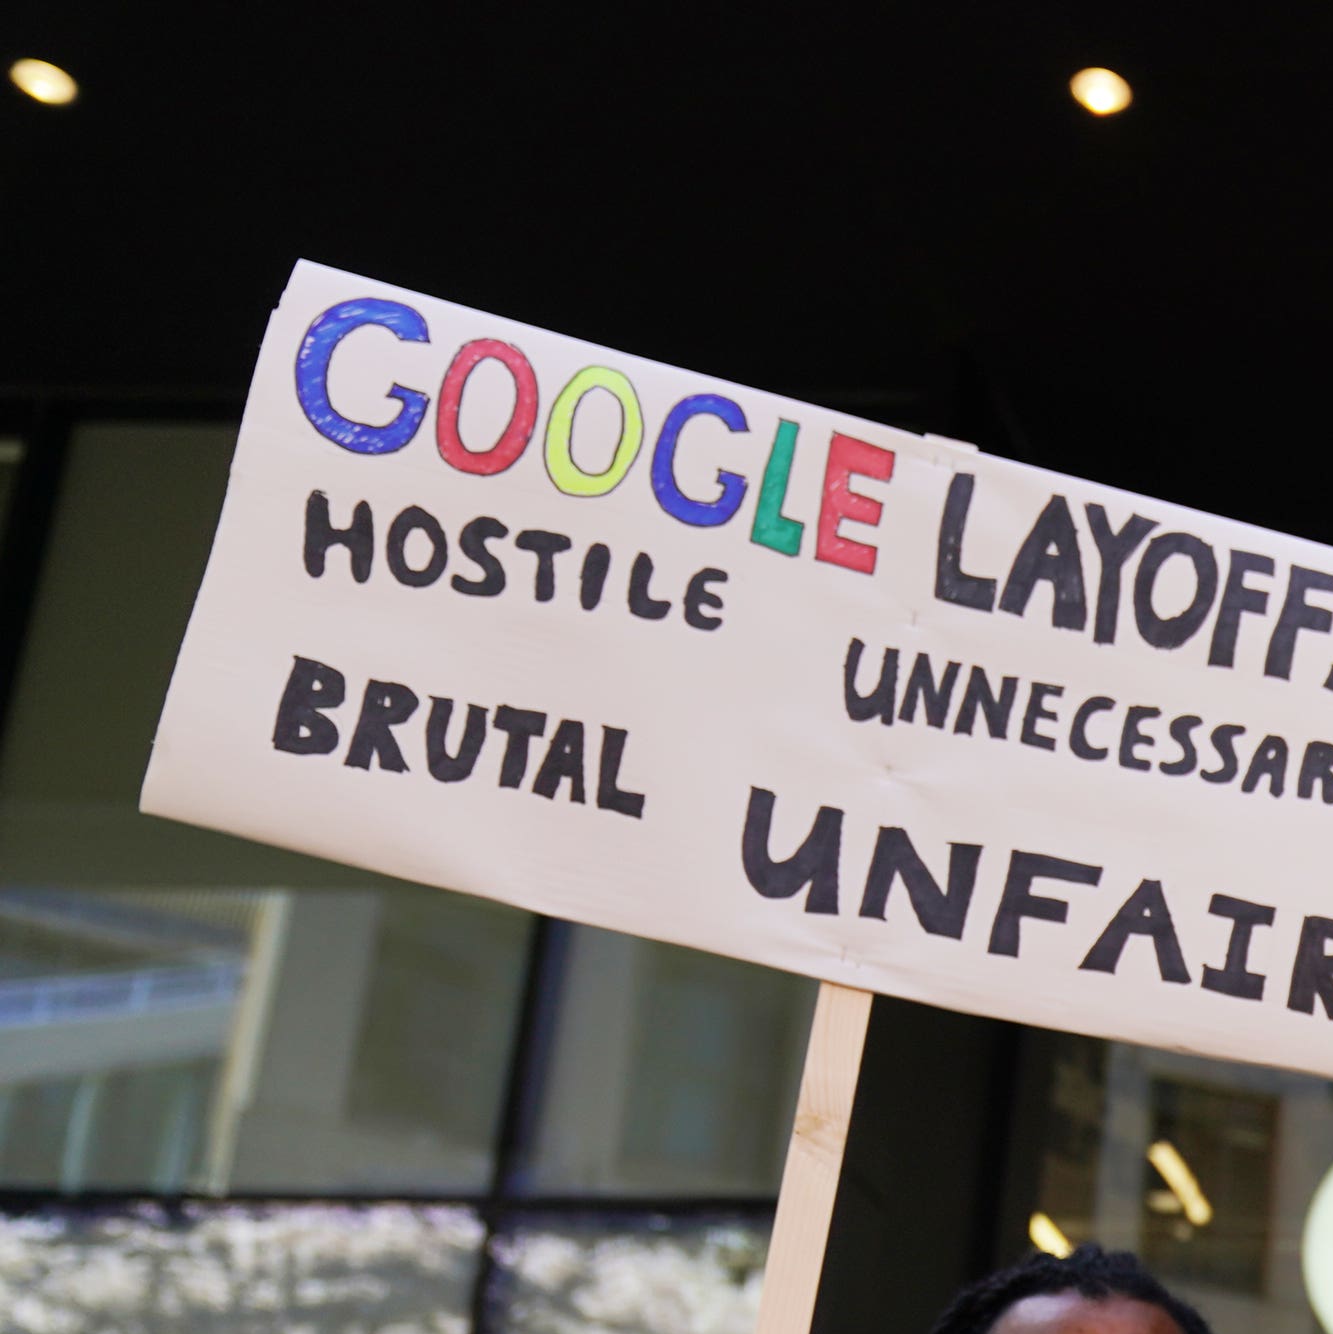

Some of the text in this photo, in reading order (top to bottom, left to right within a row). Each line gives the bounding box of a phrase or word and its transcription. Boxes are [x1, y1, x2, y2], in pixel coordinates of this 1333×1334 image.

[296, 298, 895, 574] GOOGLE
[304, 490, 728, 630] HOSTILE
[272, 656, 645, 819] BRUTAL
